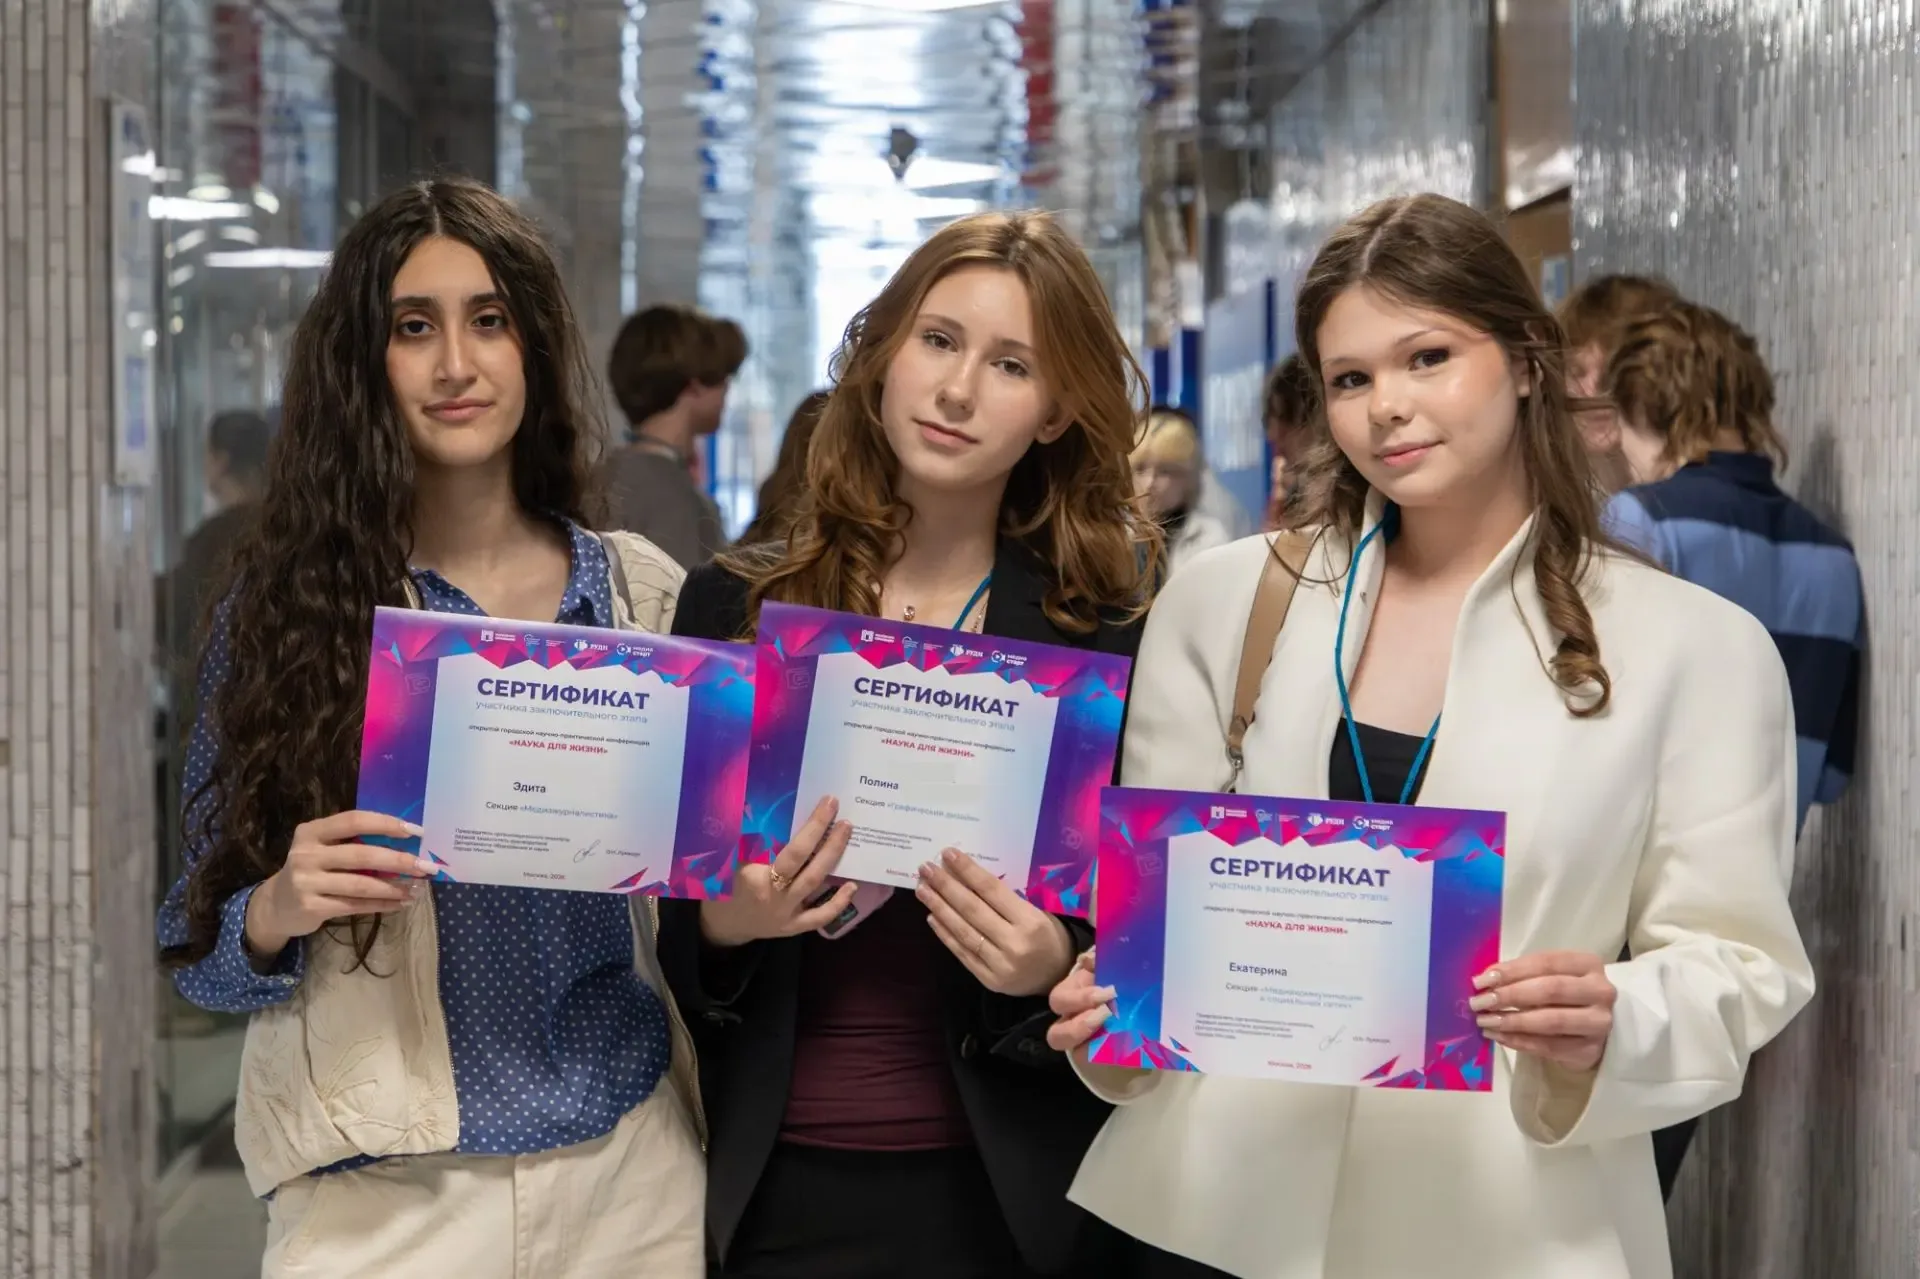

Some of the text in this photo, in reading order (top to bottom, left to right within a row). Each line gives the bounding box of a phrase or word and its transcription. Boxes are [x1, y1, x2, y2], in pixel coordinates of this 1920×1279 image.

[477, 678, 650, 710] СЕРТИФИКАТ
[854, 677, 1020, 718] СЕРТИФИКАТ
[475, 701, 648, 724] участника заключительного этапа
[850, 699, 1015, 731] участника заключительного этапа
[509, 739, 608, 754] «НАУКА ДЛЯ ЖИЗНИ»
[881, 738, 976, 758] «НАУКА ДЛЯ ЖИЗНИ»
[512, 781, 547, 794] Эдита
[859, 775, 899, 790] Полина
[485, 801, 518, 812] Секция
[855, 796, 885, 808] Секция
[1210, 857, 1391, 887] СЕРТИФИКАТ
[1208, 880, 1389, 902] участника заключительного этапа
[1245, 920, 1348, 935] «НАУКА ДЛЯ ЖИЗНИ»
[1229, 962, 1288, 977] Екатерина
